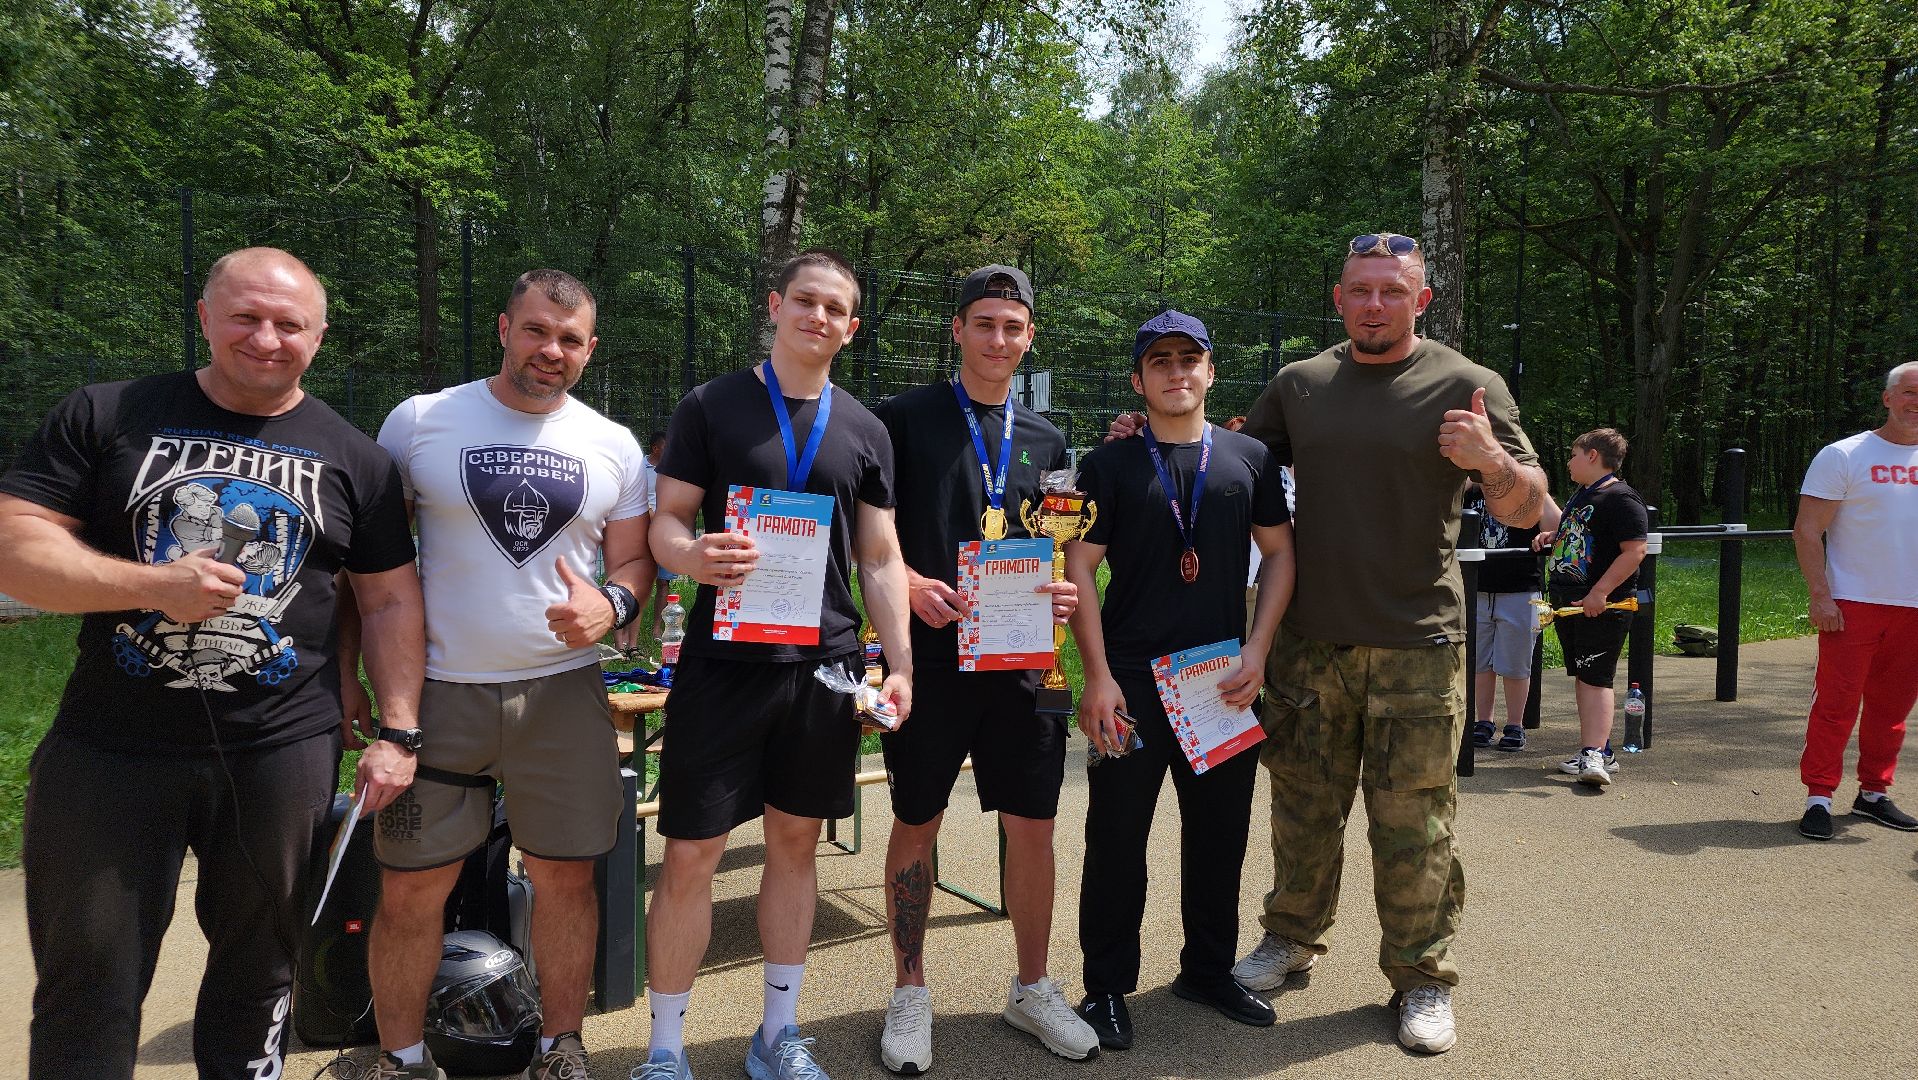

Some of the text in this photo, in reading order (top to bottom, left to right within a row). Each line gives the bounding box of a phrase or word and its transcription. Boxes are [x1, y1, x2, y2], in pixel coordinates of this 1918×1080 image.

[163, 427, 320, 458] RUSSIAN REBEL POETRY
[468, 450, 580, 475] СЕВЕРНЫЙ
[479, 465, 576, 484] ЧЕЛОВЕК
[124, 436, 326, 534] ЕСЕНИН
[757, 514, 817, 537] ГРАМОТА
[985, 558, 1040, 576] ГРАМОТА
[242, 600, 268, 613] ЖЕ
[1179, 654, 1230, 681] ГРАМОТА
